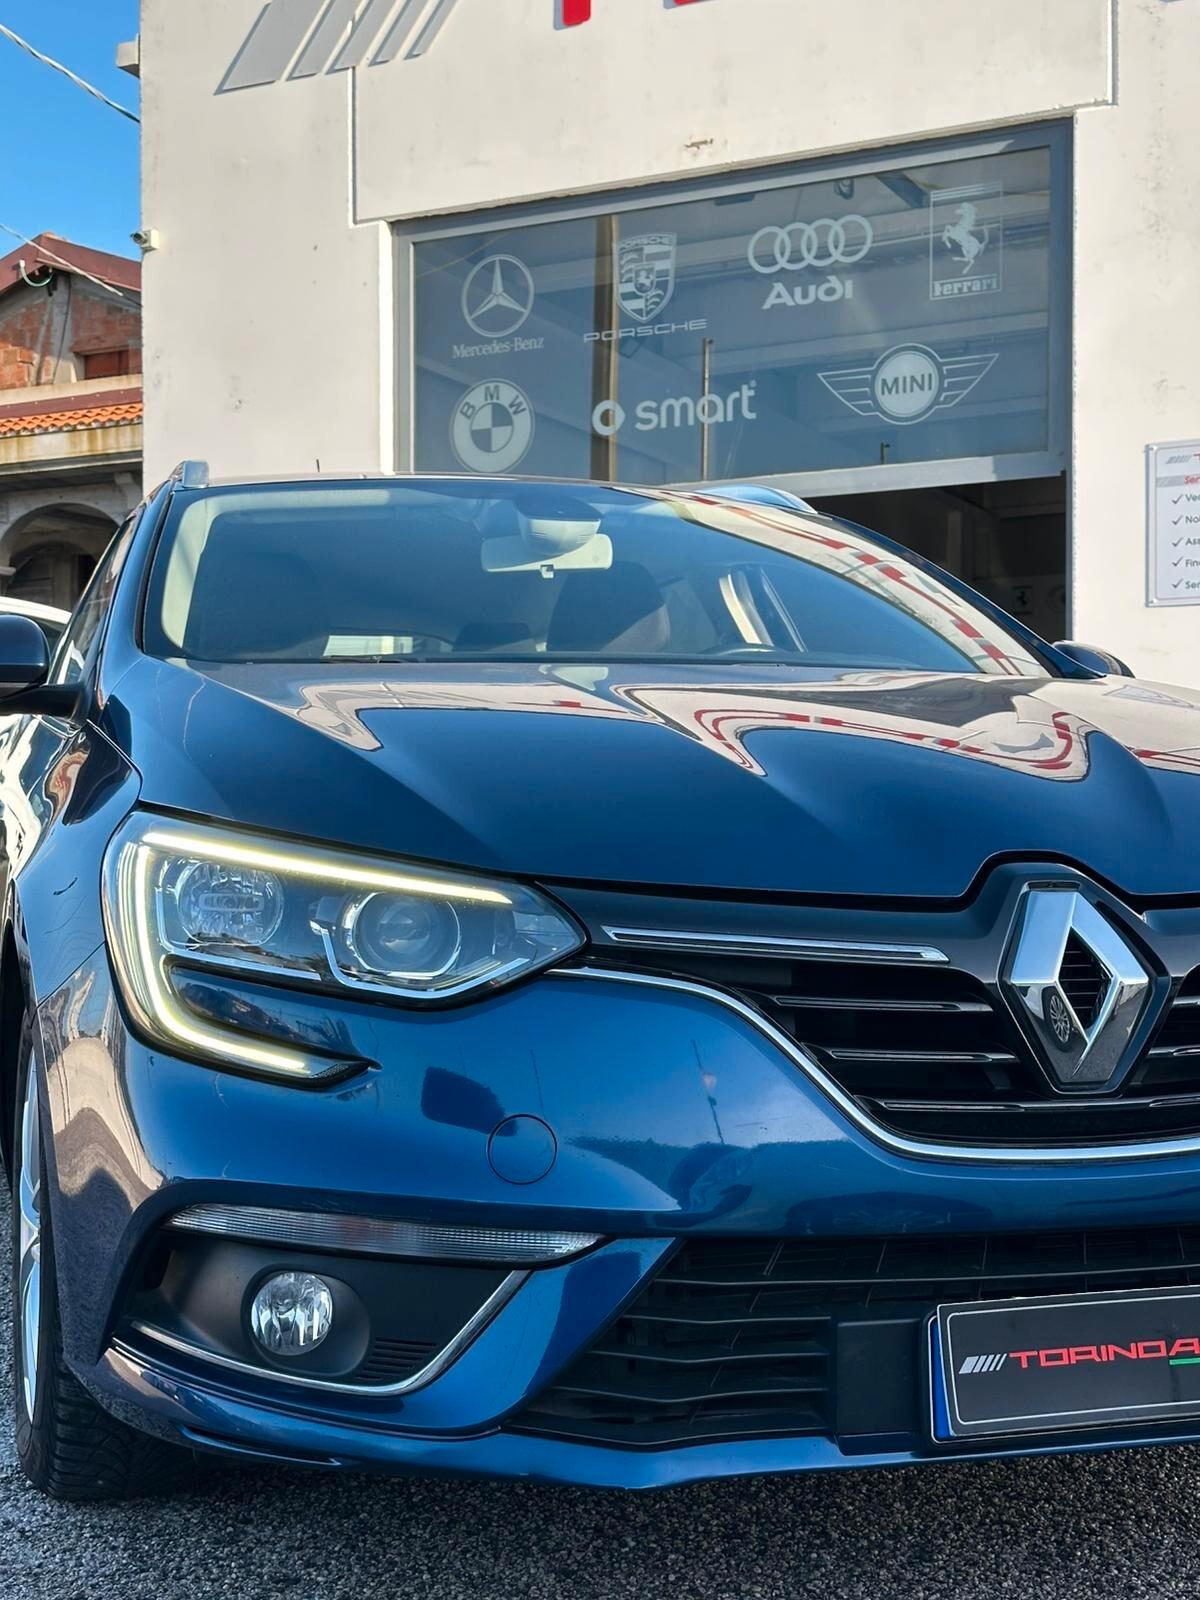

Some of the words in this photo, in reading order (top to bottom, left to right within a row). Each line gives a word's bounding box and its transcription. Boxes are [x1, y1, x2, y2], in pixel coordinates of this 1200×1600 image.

[762, 275, 853, 310] Audi
[583, 319, 708, 343] PORSCHE
[452, 337, 545, 359] Mercedes-Benz
[880, 372, 934, 396] MINI
[459, 385, 527, 420] BMW
[634, 380, 757, 431] smart
